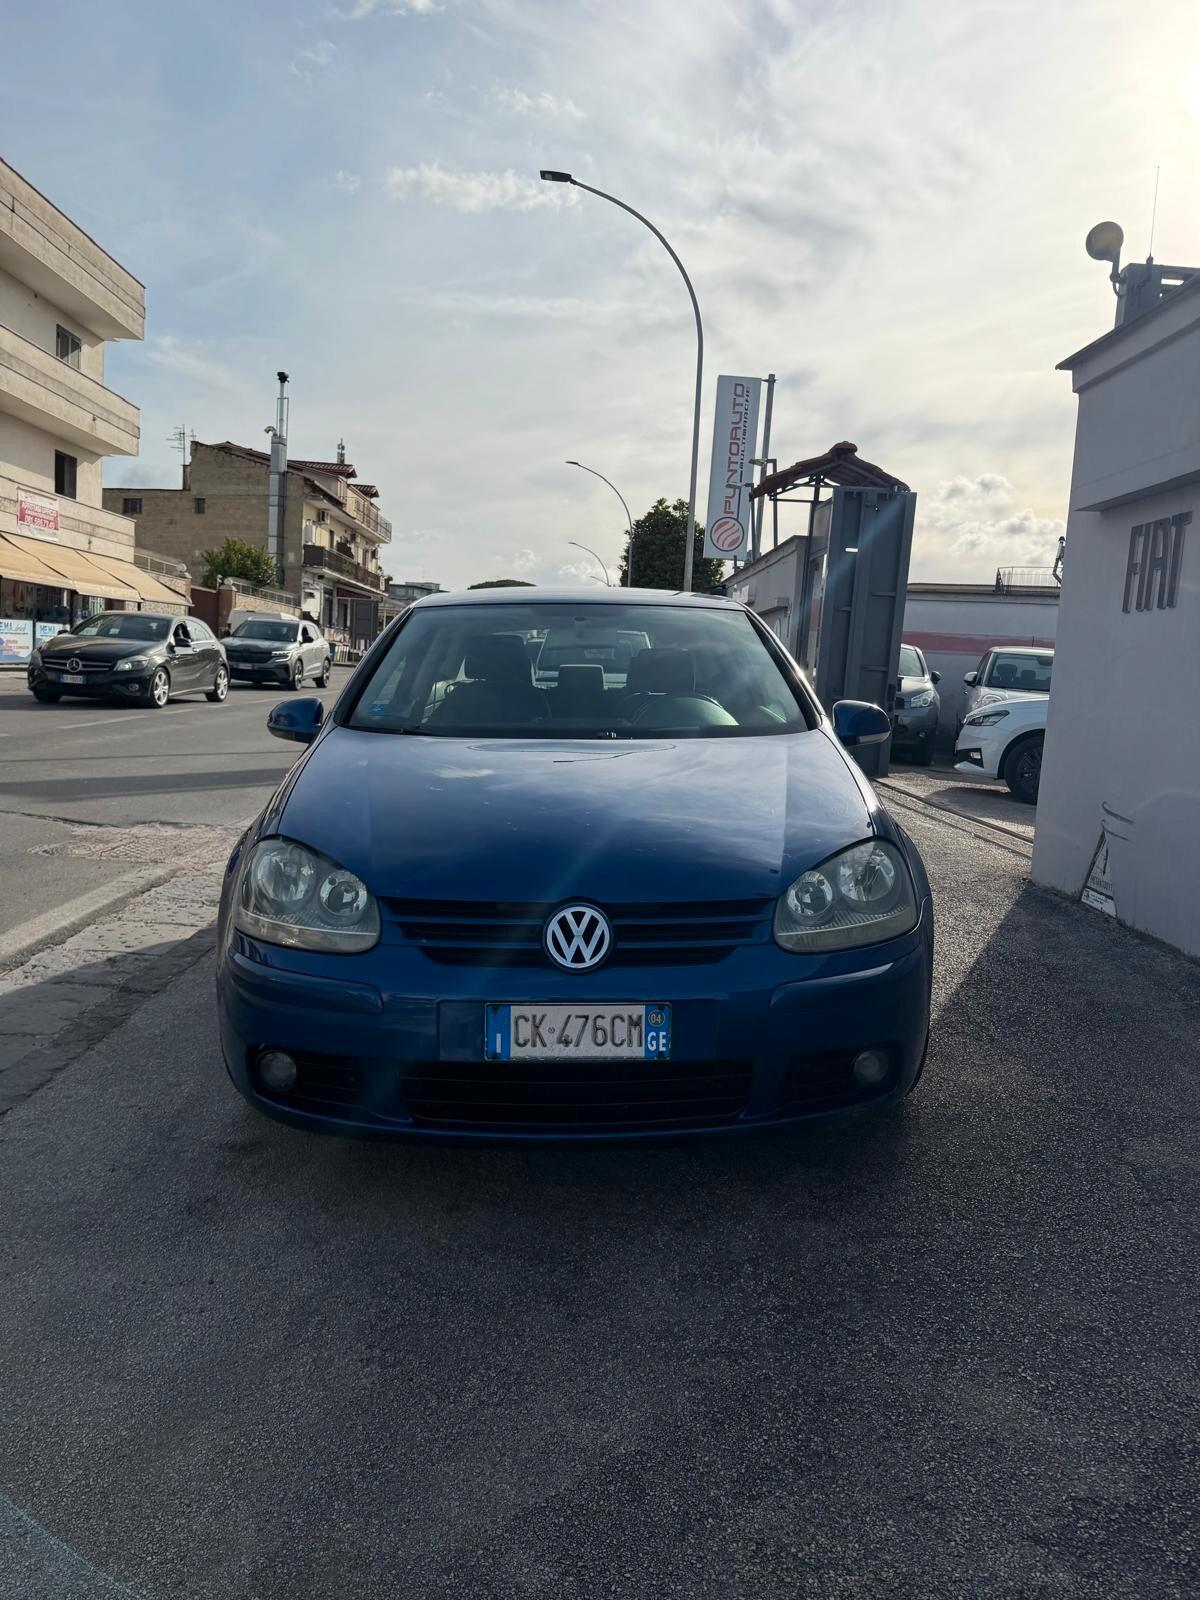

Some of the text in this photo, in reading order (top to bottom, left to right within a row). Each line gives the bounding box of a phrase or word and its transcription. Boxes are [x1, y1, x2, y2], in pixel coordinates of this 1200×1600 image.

[650, 1013, 662, 1024] 04
[513, 1013, 643, 1048] CK 476CM
[647, 1031, 667, 1052] GE
